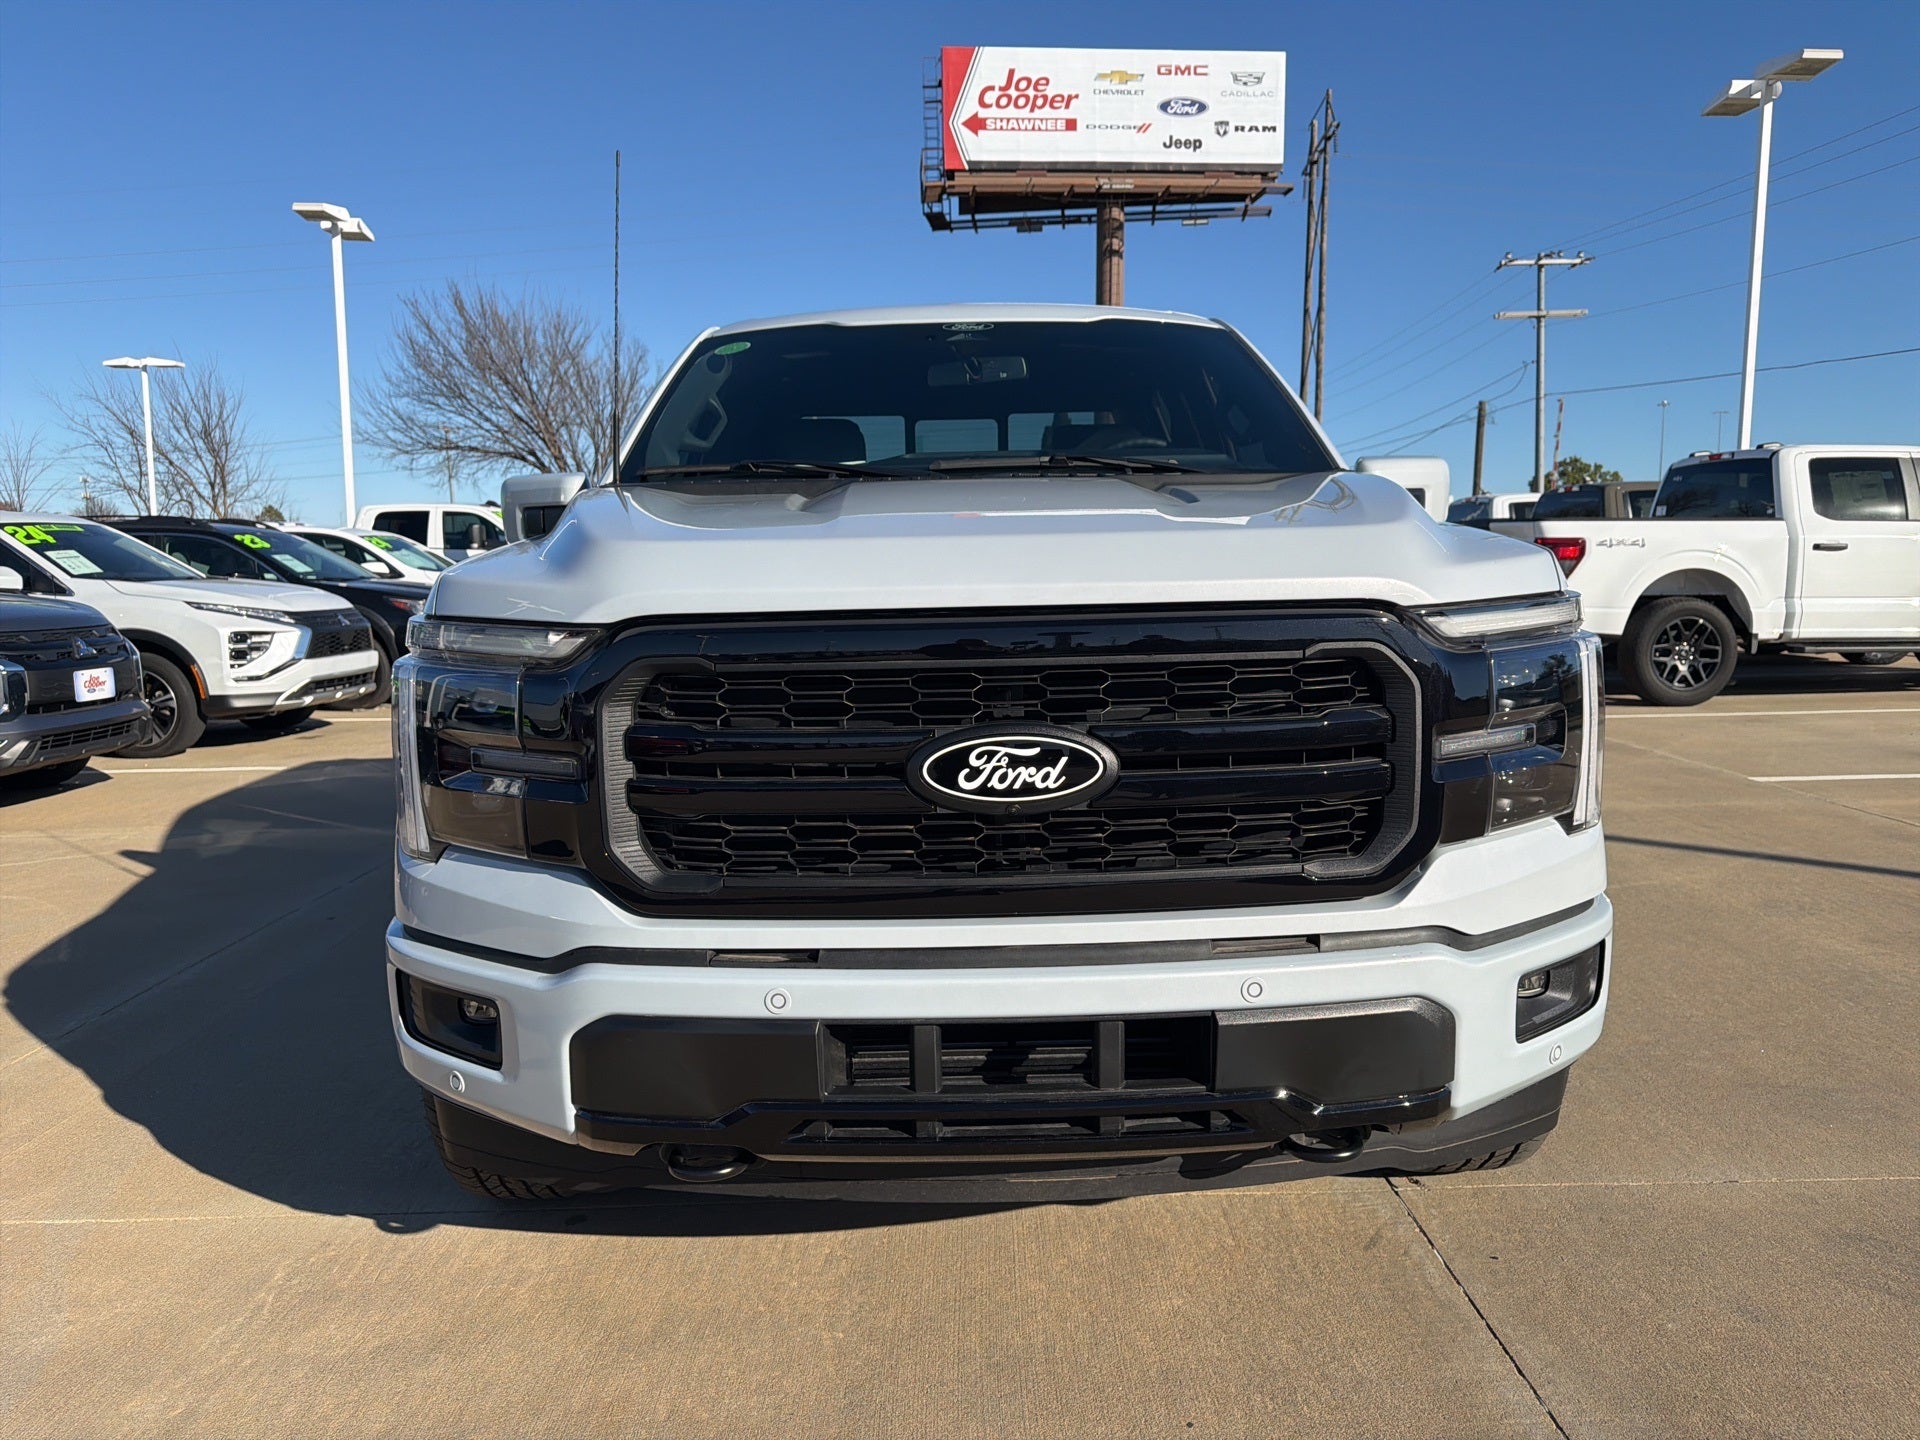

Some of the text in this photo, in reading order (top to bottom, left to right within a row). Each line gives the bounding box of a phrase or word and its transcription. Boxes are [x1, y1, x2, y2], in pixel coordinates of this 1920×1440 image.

[1157, 64, 1209, 77] GMC
[998, 68, 1050, 93] Joe
[1093, 88, 1145, 96] CHEVROLET
[1220, 90, 1275, 98] CADILLAC
[977, 85, 1080, 114] Cooper
[1166, 99, 1200, 115] Ford
[985, 118, 1066, 131] SHAWNEE
[1085, 123, 1140, 131] DODGE
[1234, 125, 1277, 133] RAM
[1162, 135, 1203, 151] Jeep
[951, 323, 985, 331] Ford
[3, 525, 57, 545] 24
[958, 745, 1069, 790] Ford
